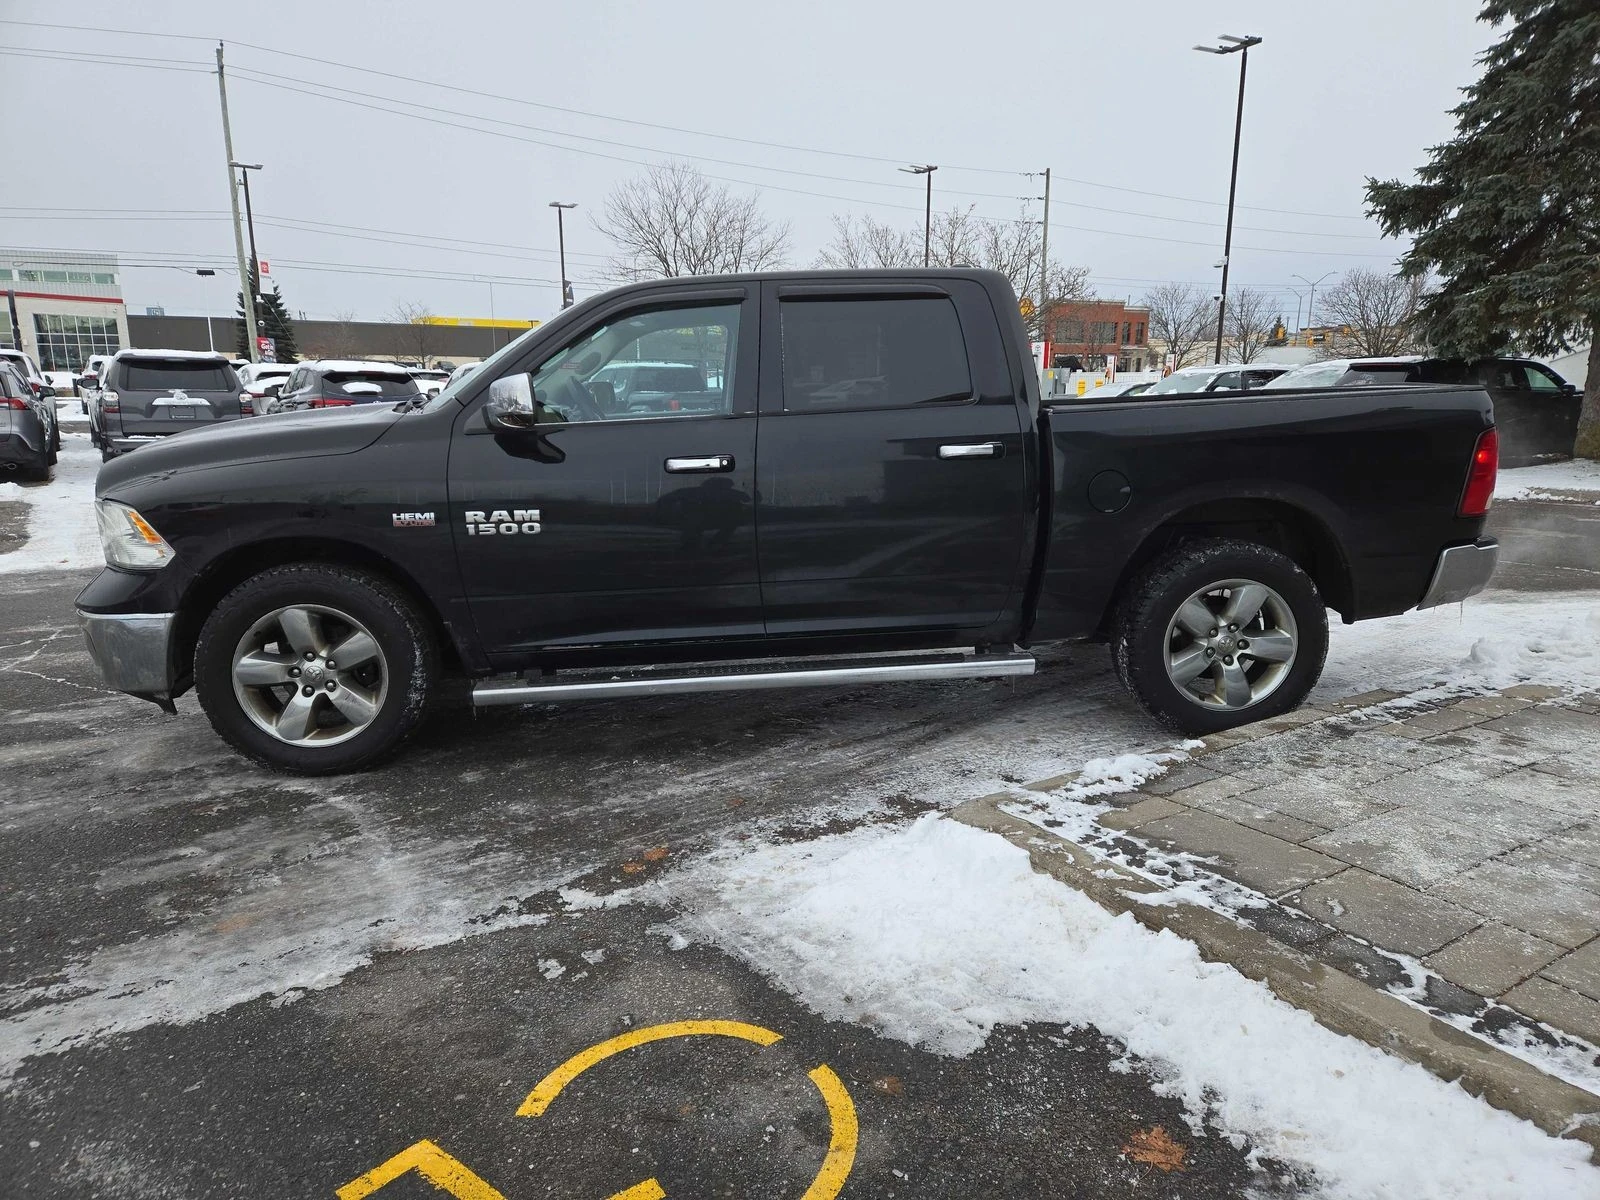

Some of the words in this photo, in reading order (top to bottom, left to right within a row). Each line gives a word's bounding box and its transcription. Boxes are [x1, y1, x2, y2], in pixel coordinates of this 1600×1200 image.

[392, 512, 435, 521] HEMI
[465, 509, 541, 523] RAM
[465, 522, 541, 536] 1500
